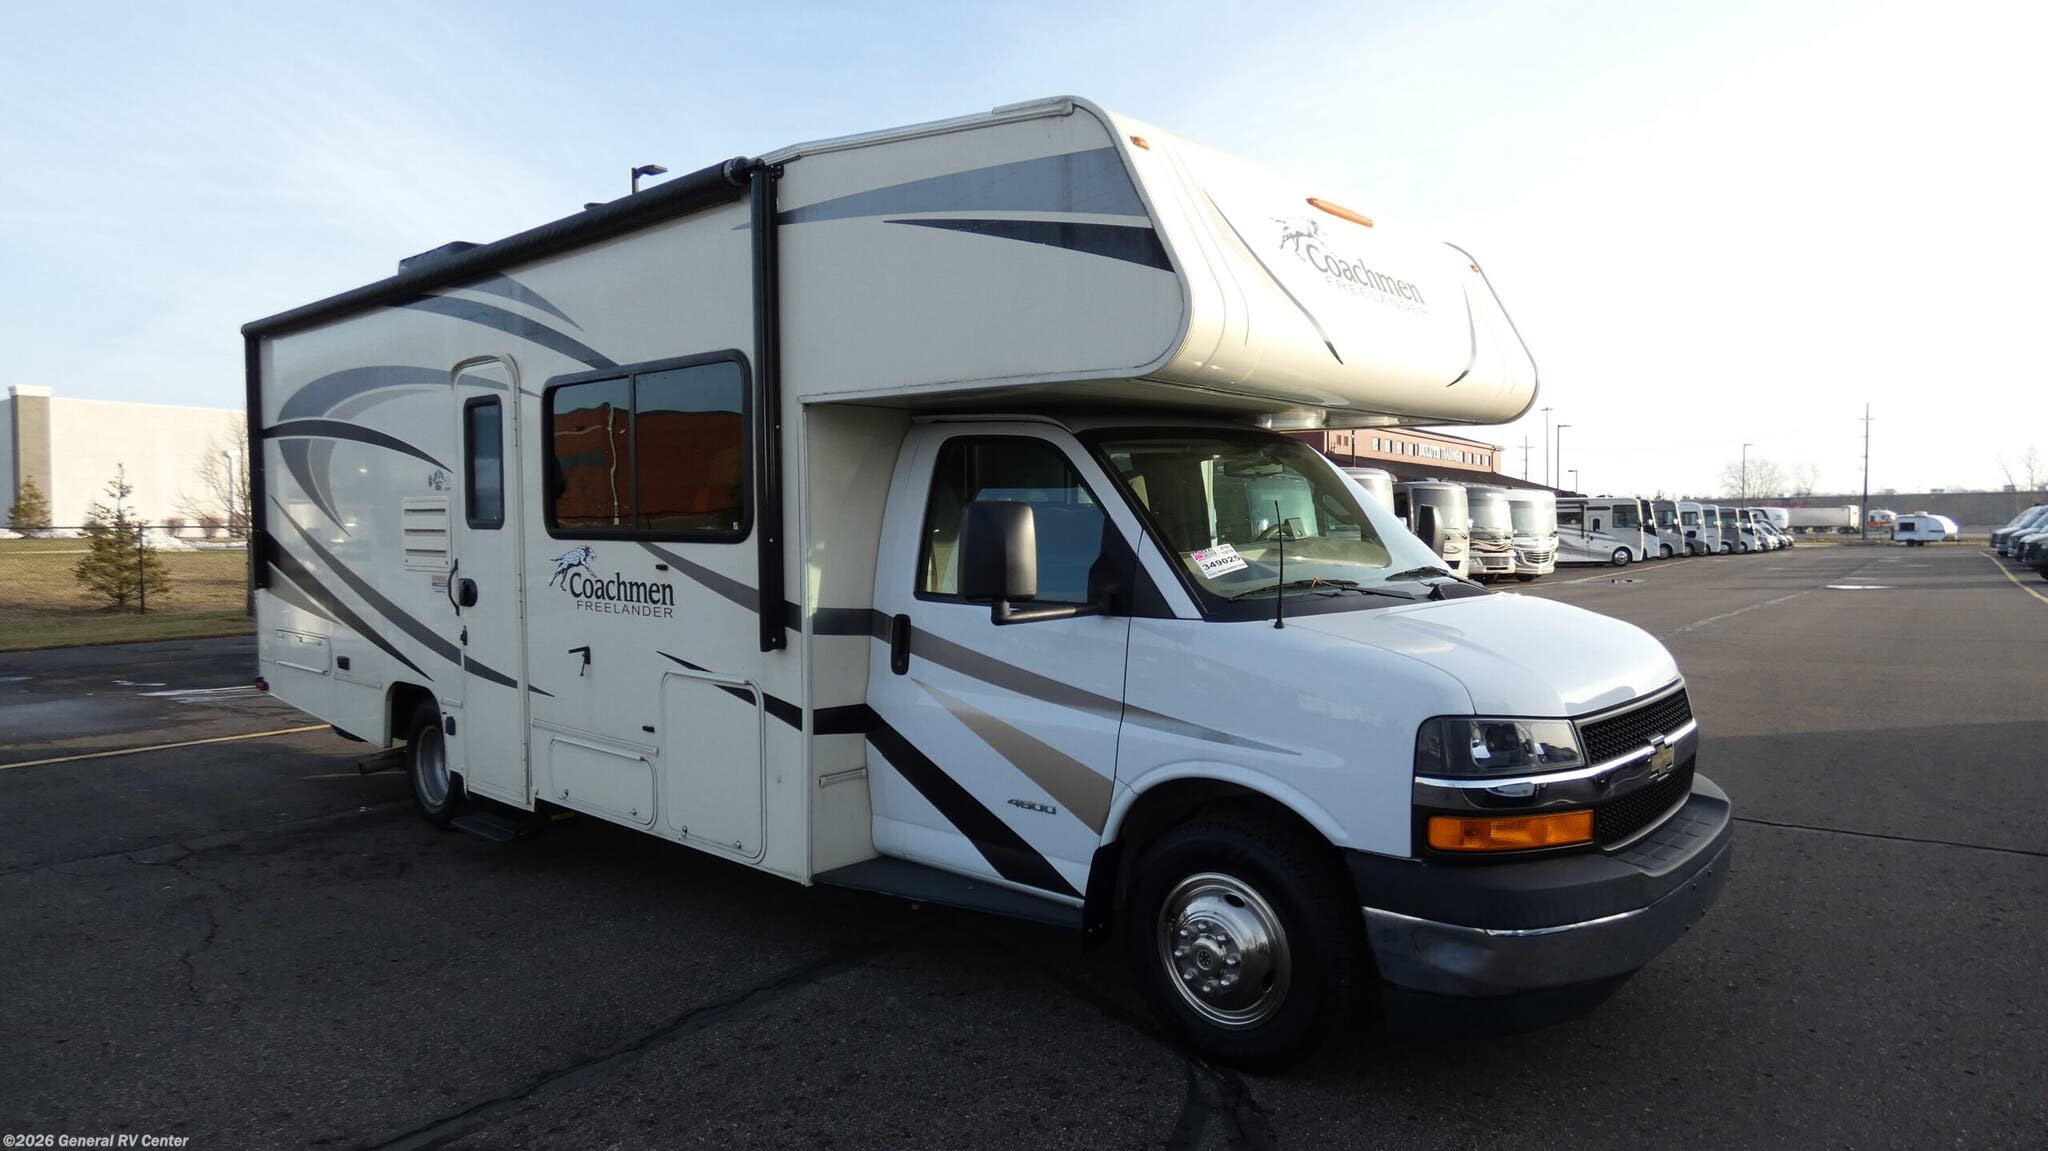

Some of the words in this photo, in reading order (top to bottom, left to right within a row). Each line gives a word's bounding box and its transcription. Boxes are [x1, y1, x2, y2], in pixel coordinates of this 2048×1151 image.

[1306, 243, 1427, 305] Coachmen
[1202, 554, 1241, 571] 349025
[569, 571, 675, 606] Coachmen
[576, 600, 674, 619] FREELANDER
